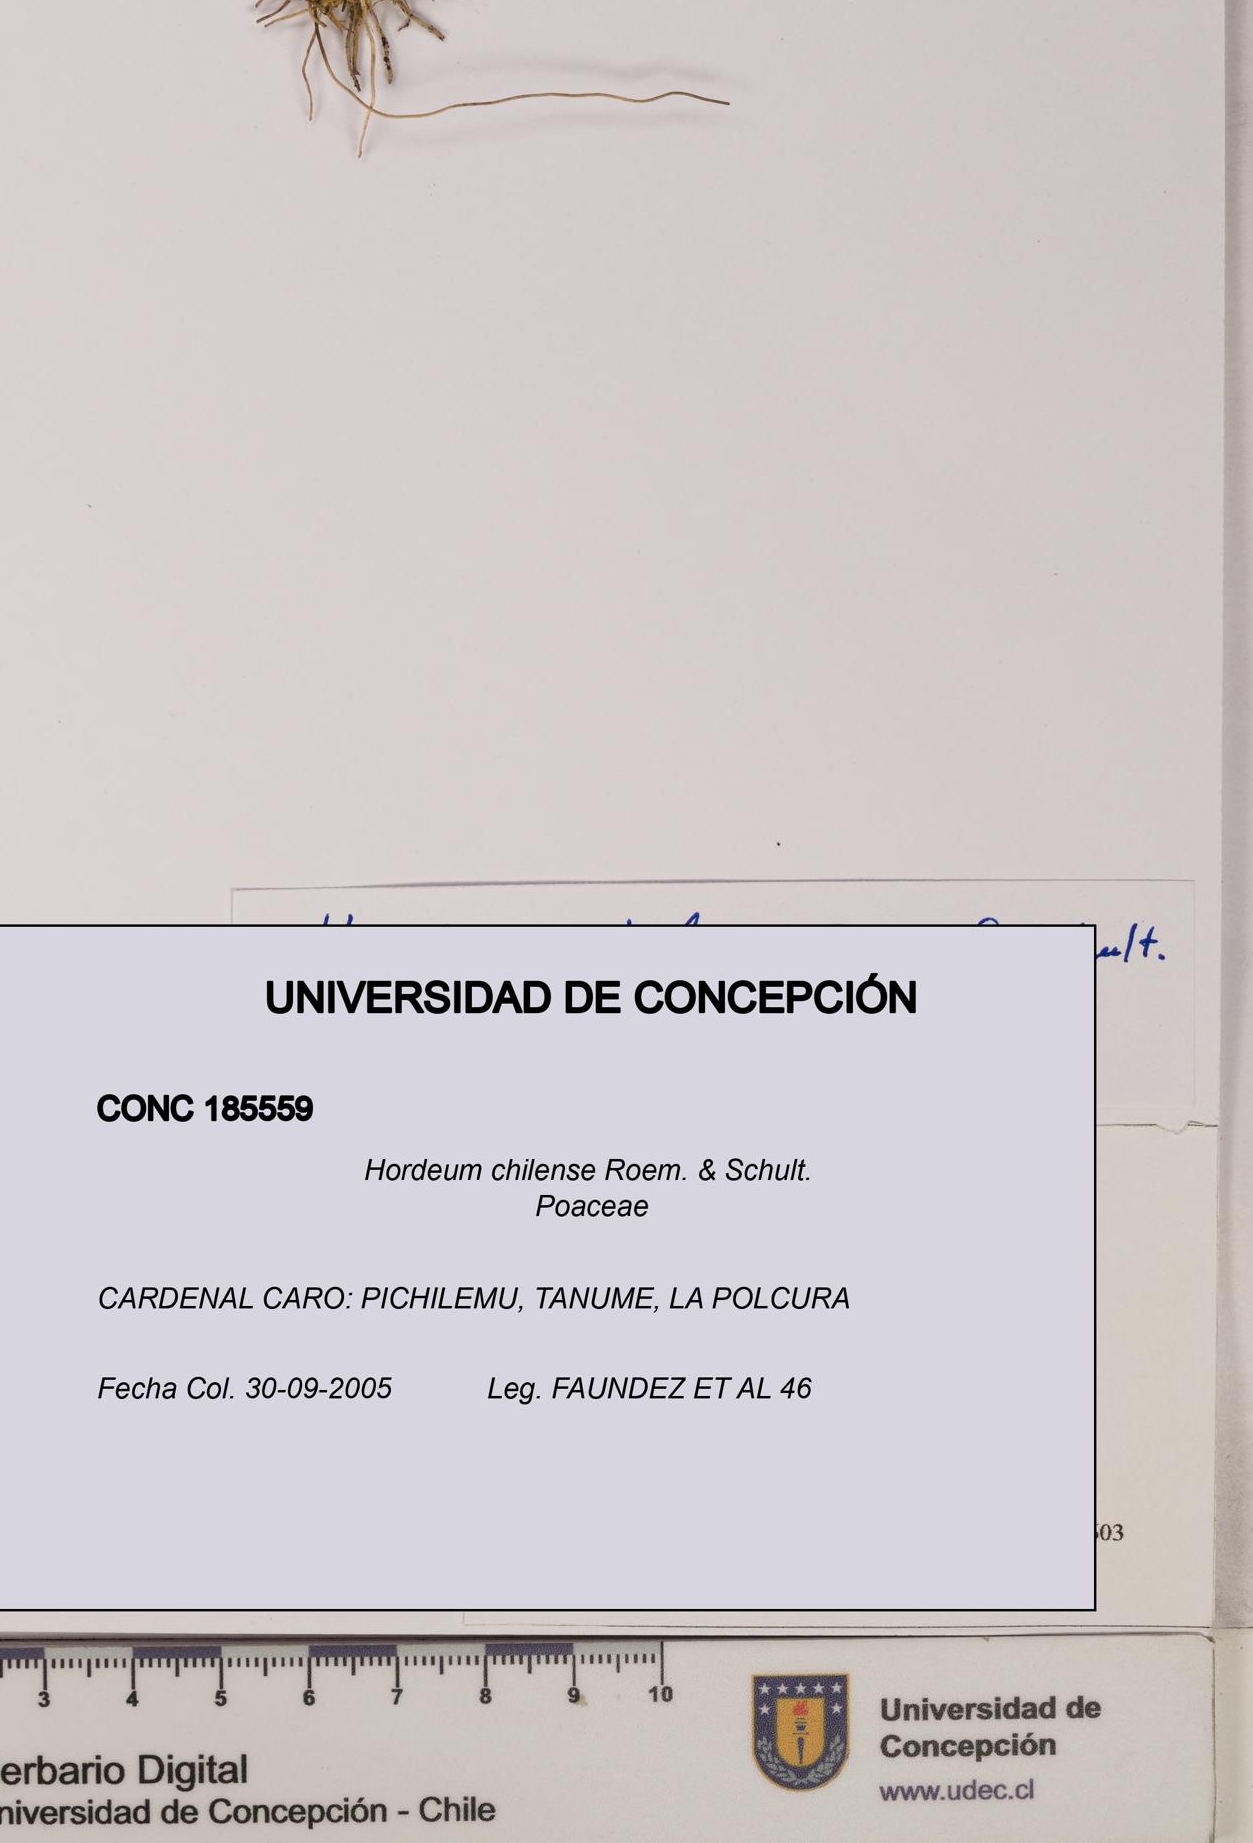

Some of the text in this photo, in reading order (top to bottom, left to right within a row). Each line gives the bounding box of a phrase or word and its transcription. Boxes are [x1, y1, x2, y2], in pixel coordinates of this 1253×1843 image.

[1096, 922, 1166, 963] ult.
[37, 1691, 51, 1708] 3
[125, 1691, 140, 1707] 4
[214, 1690, 228, 1707] 5
[302, 1689, 316, 1707] 6
[391, 1689, 404, 1706] 7
[479, 1688, 493, 1705] 8
[567, 1687, 581, 1704] 9
[648, 1686, 674, 1703] 10
[881, 1695, 1102, 1722] Universidad de
[879, 1731, 1057, 1764] Concepción
[138, 1753, 248, 1793] Digital
[878, 1778, 1034, 1803] www.udec.cl
[160, 1798, 199, 1825] de
[208, 1796, 388, 1831] Concepción
[419, 1795, 497, 1823] Chile
